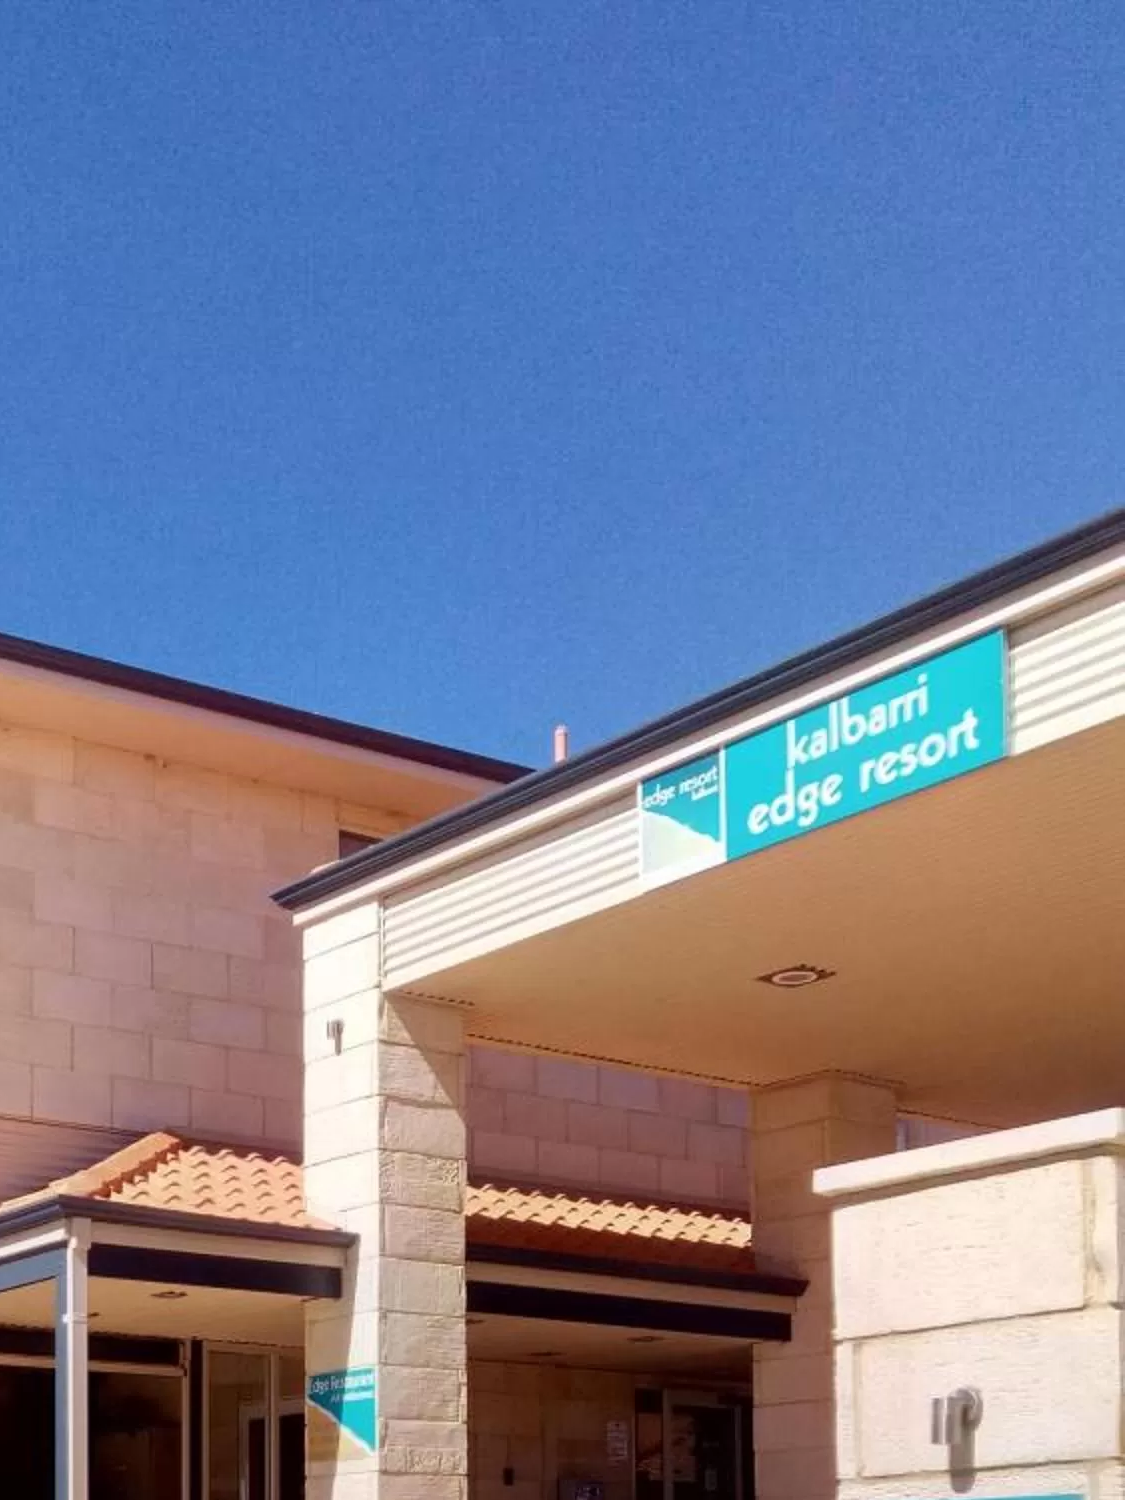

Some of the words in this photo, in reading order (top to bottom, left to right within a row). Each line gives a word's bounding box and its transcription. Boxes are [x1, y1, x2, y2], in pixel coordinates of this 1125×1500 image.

[786, 673, 929, 768] kalbarri
[644, 783, 676, 808] edge
[679, 766, 718, 794] resort
[747, 768, 843, 834] edge
[859, 707, 980, 793] resort
